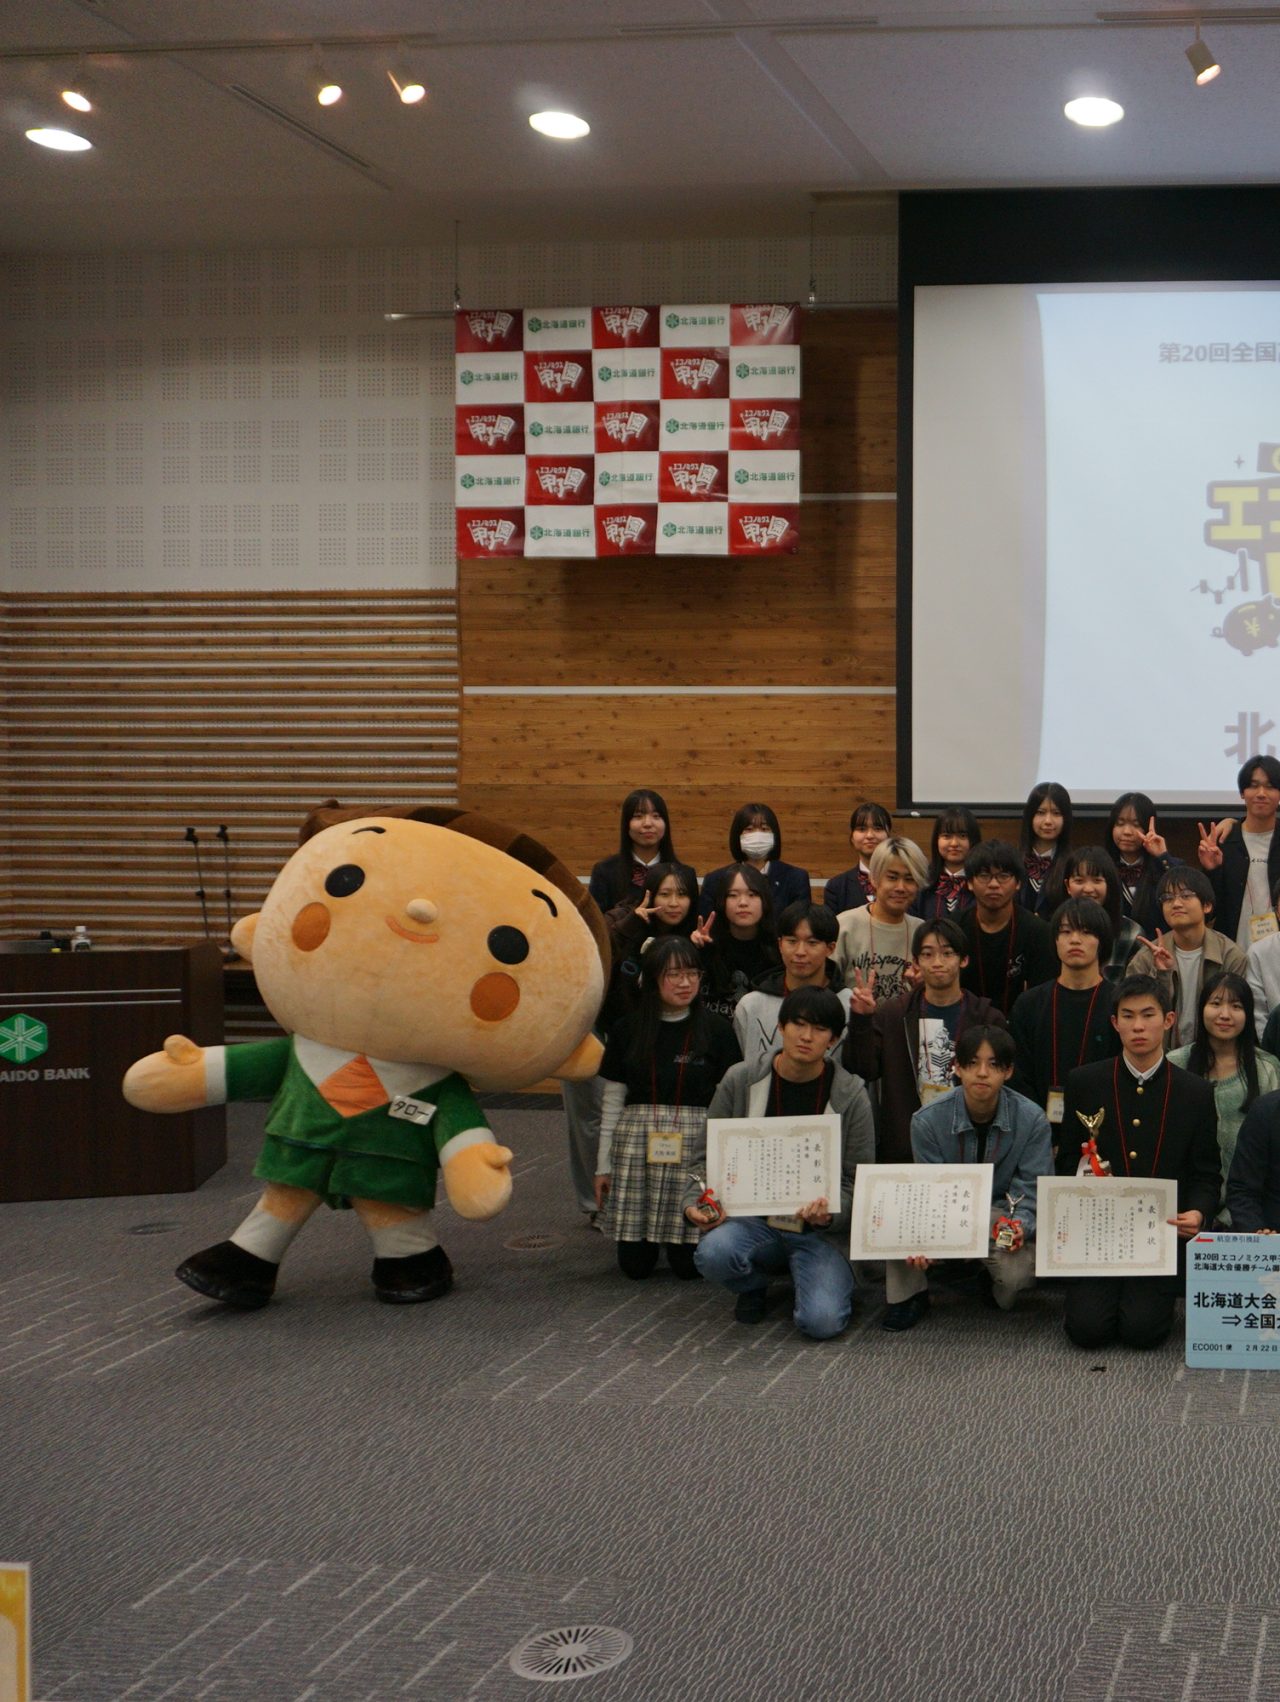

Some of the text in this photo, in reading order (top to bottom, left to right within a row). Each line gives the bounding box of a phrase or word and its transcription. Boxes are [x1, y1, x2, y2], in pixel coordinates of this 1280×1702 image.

[542, 319, 585, 329] 北海道銀行
[680, 316, 725, 326] 北海道銀行
[613, 368, 655, 378] 北海道銀行
[750, 366, 795, 376] 北海道銀行
[475, 371, 518, 382] 北海道銀行
[543, 425, 589, 434] 北海道銀行
[680, 421, 725, 431] 北海道銀行
[476, 477, 520, 486] 北海道銀行
[611, 473, 653, 482] 北海道銀行
[750, 472, 796, 481] 北海道銀行
[543, 528, 590, 538] 北海道銀行
[678, 526, 722, 535] 北海道銀行
[43, 1067, 90, 1080] BANK
[394, 1101, 429, 1116] タロー
[813, 1143, 822, 1184] 表彰状
[959, 1190, 971, 1228] 表彰状
[1147, 1205, 1157, 1246] 表彰状
[1194, 1252, 1219, 1261] 第20回
[1194, 1292, 1277, 1309] 北海道大会
[1192, 1343, 1223, 1351] ECO001
